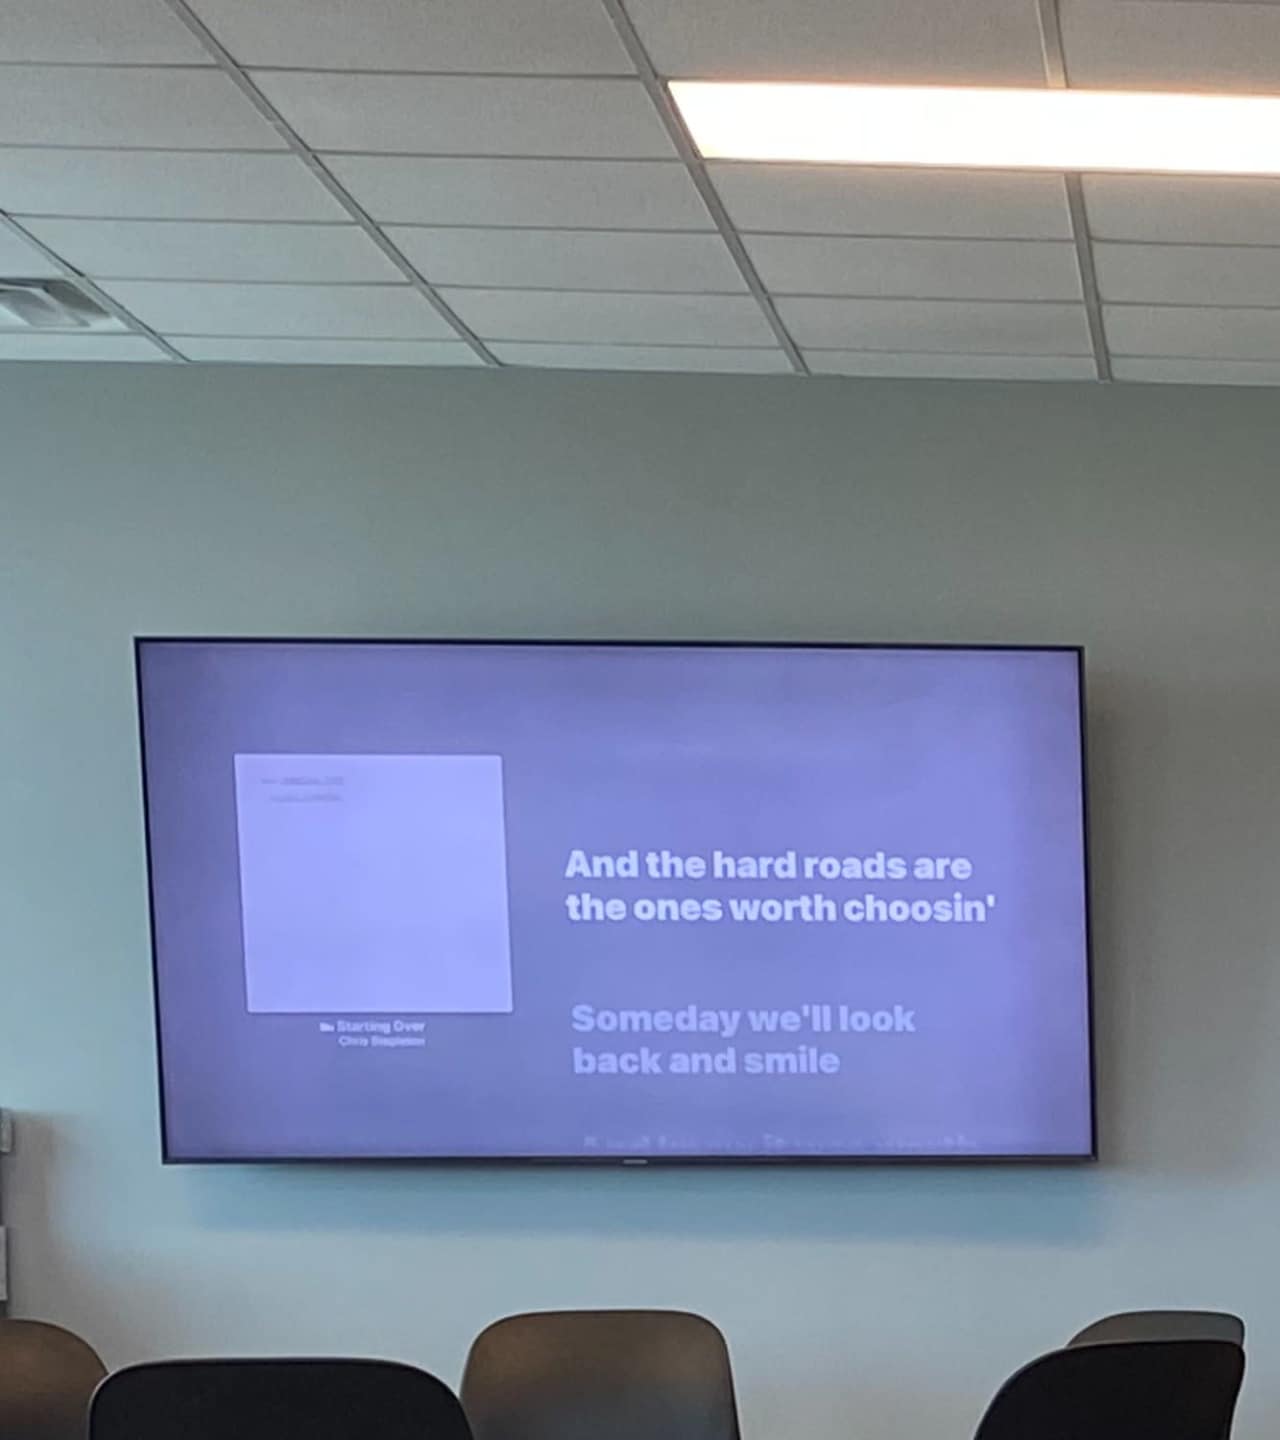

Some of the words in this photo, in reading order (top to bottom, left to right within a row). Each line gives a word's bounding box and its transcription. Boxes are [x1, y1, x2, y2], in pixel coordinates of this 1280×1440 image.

[565, 850, 638, 879] And
[645, 851, 705, 879] the
[713, 850, 797, 880] hard
[804, 852, 907, 880] roads
[913, 857, 972, 880] are
[566, 893, 626, 921] the
[633, 898, 723, 921] ones
[730, 894, 837, 922] worth
[844, 892, 995, 922] choosin'
[572, 1004, 741, 1037] Someday
[748, 1004, 834, 1032] we'll
[839, 1004, 916, 1032] look
[573, 1046, 662, 1074] back
[669, 1046, 736, 1074] and
[744, 1045, 841, 1074] smile
